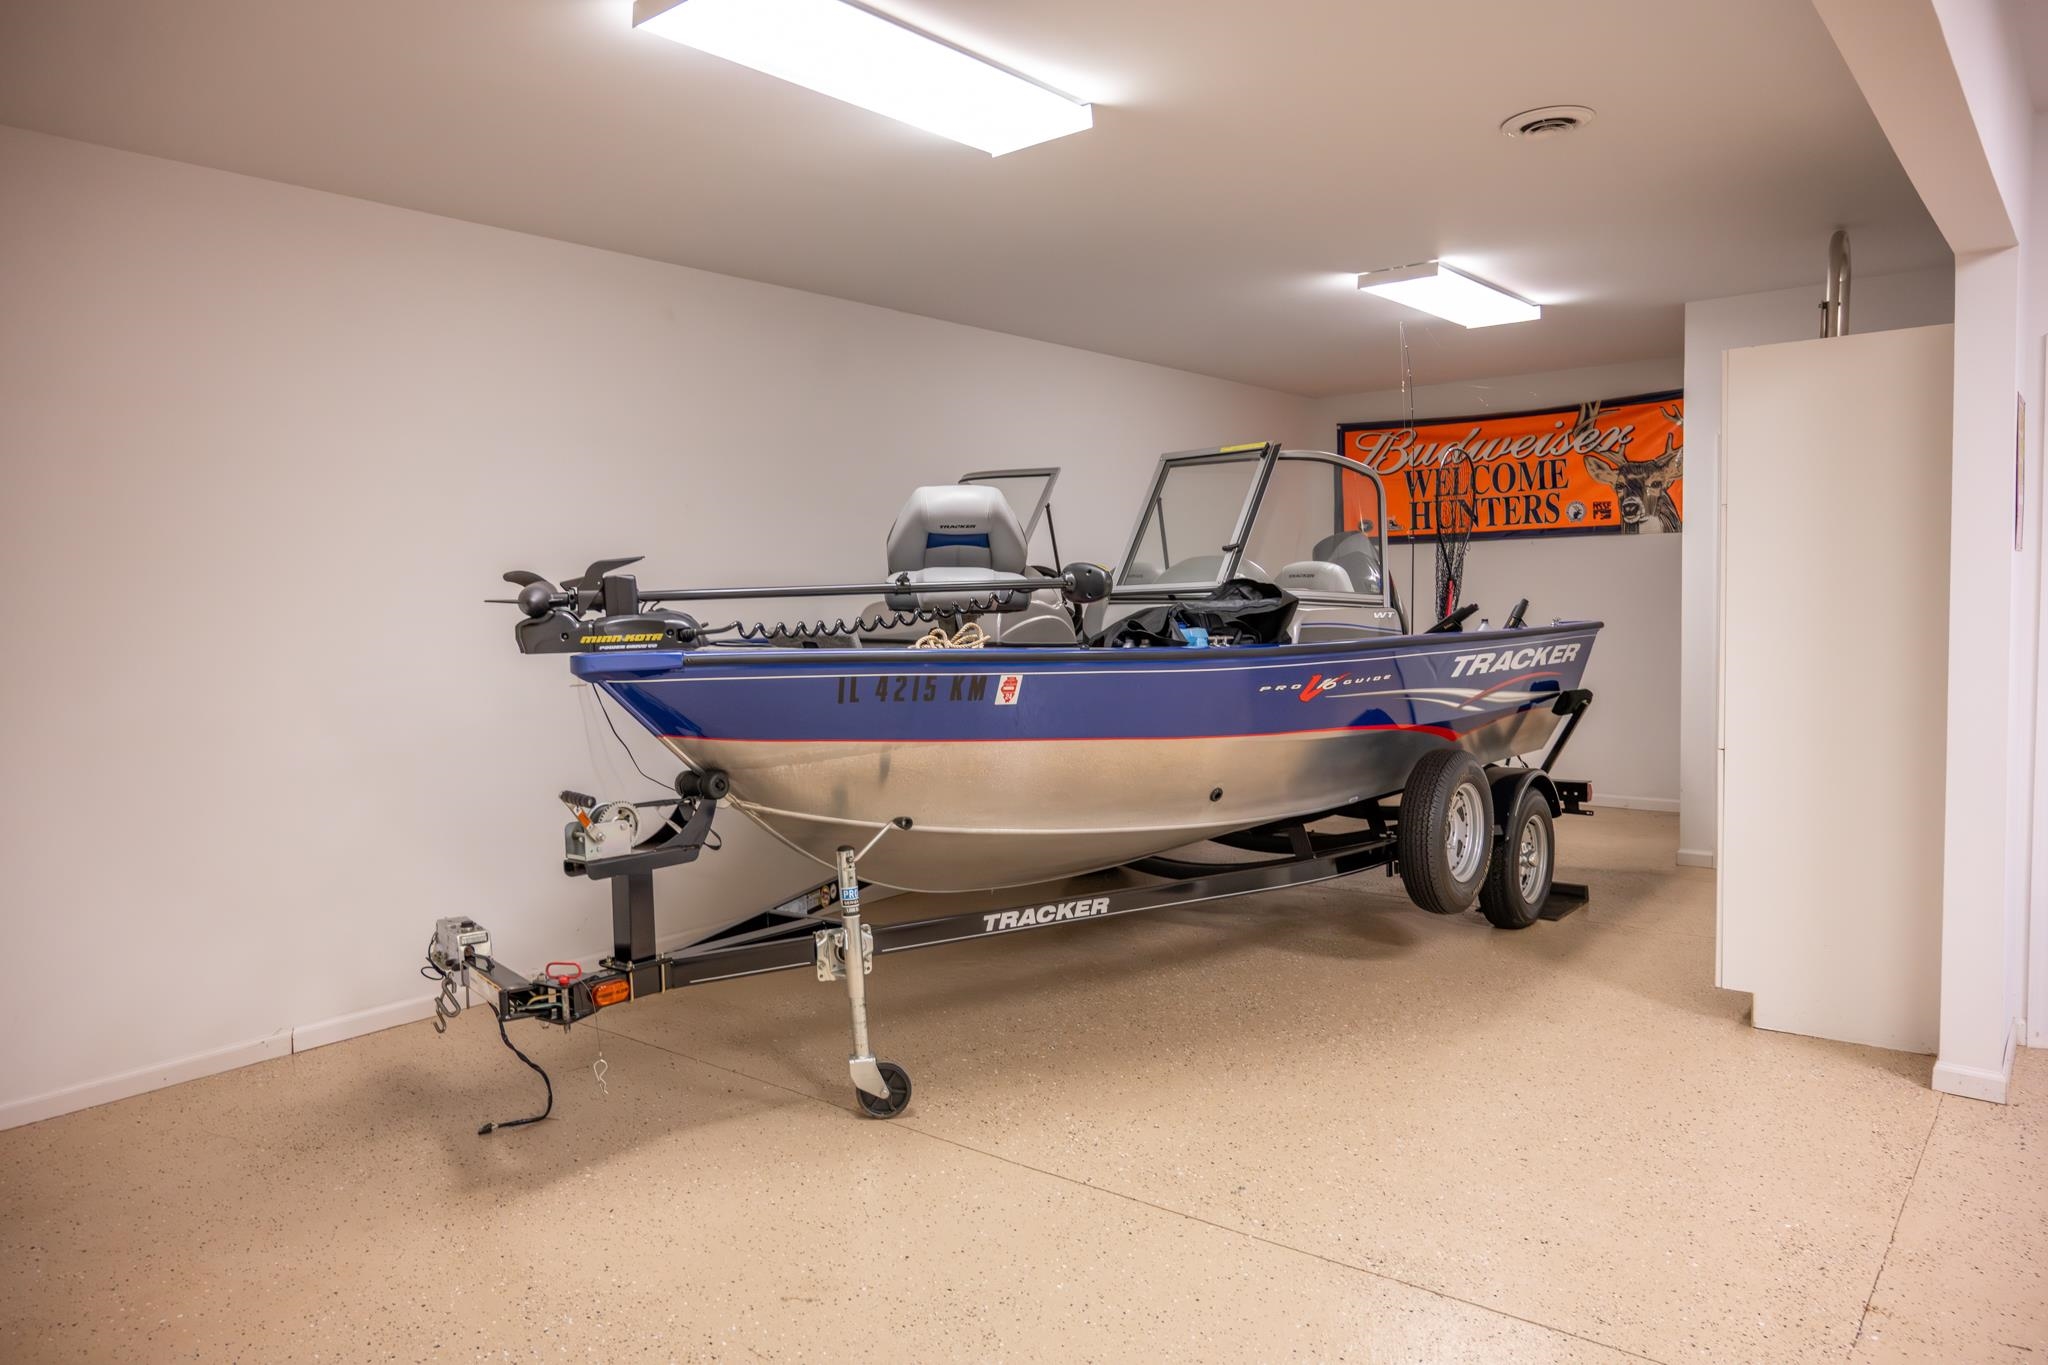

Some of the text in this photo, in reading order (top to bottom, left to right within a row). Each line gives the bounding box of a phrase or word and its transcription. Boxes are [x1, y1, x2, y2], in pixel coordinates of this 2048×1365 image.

[1356, 421, 1634, 474] Budweiser
[1404, 458, 1569, 499] WELCOME
[1408, 493, 1561, 531] HUNTERS
[1373, 611, 1396, 619] WT
[1451, 643, 1581, 678] TRACKER
[837, 677, 860, 705] IL
[875, 675, 939, 703] 4215
[949, 674, 988, 702] KM
[1259, 683, 1302, 692] PRO
[1343, 673, 1393, 686] GUIDE
[983, 897, 1110, 932] TRACKER
